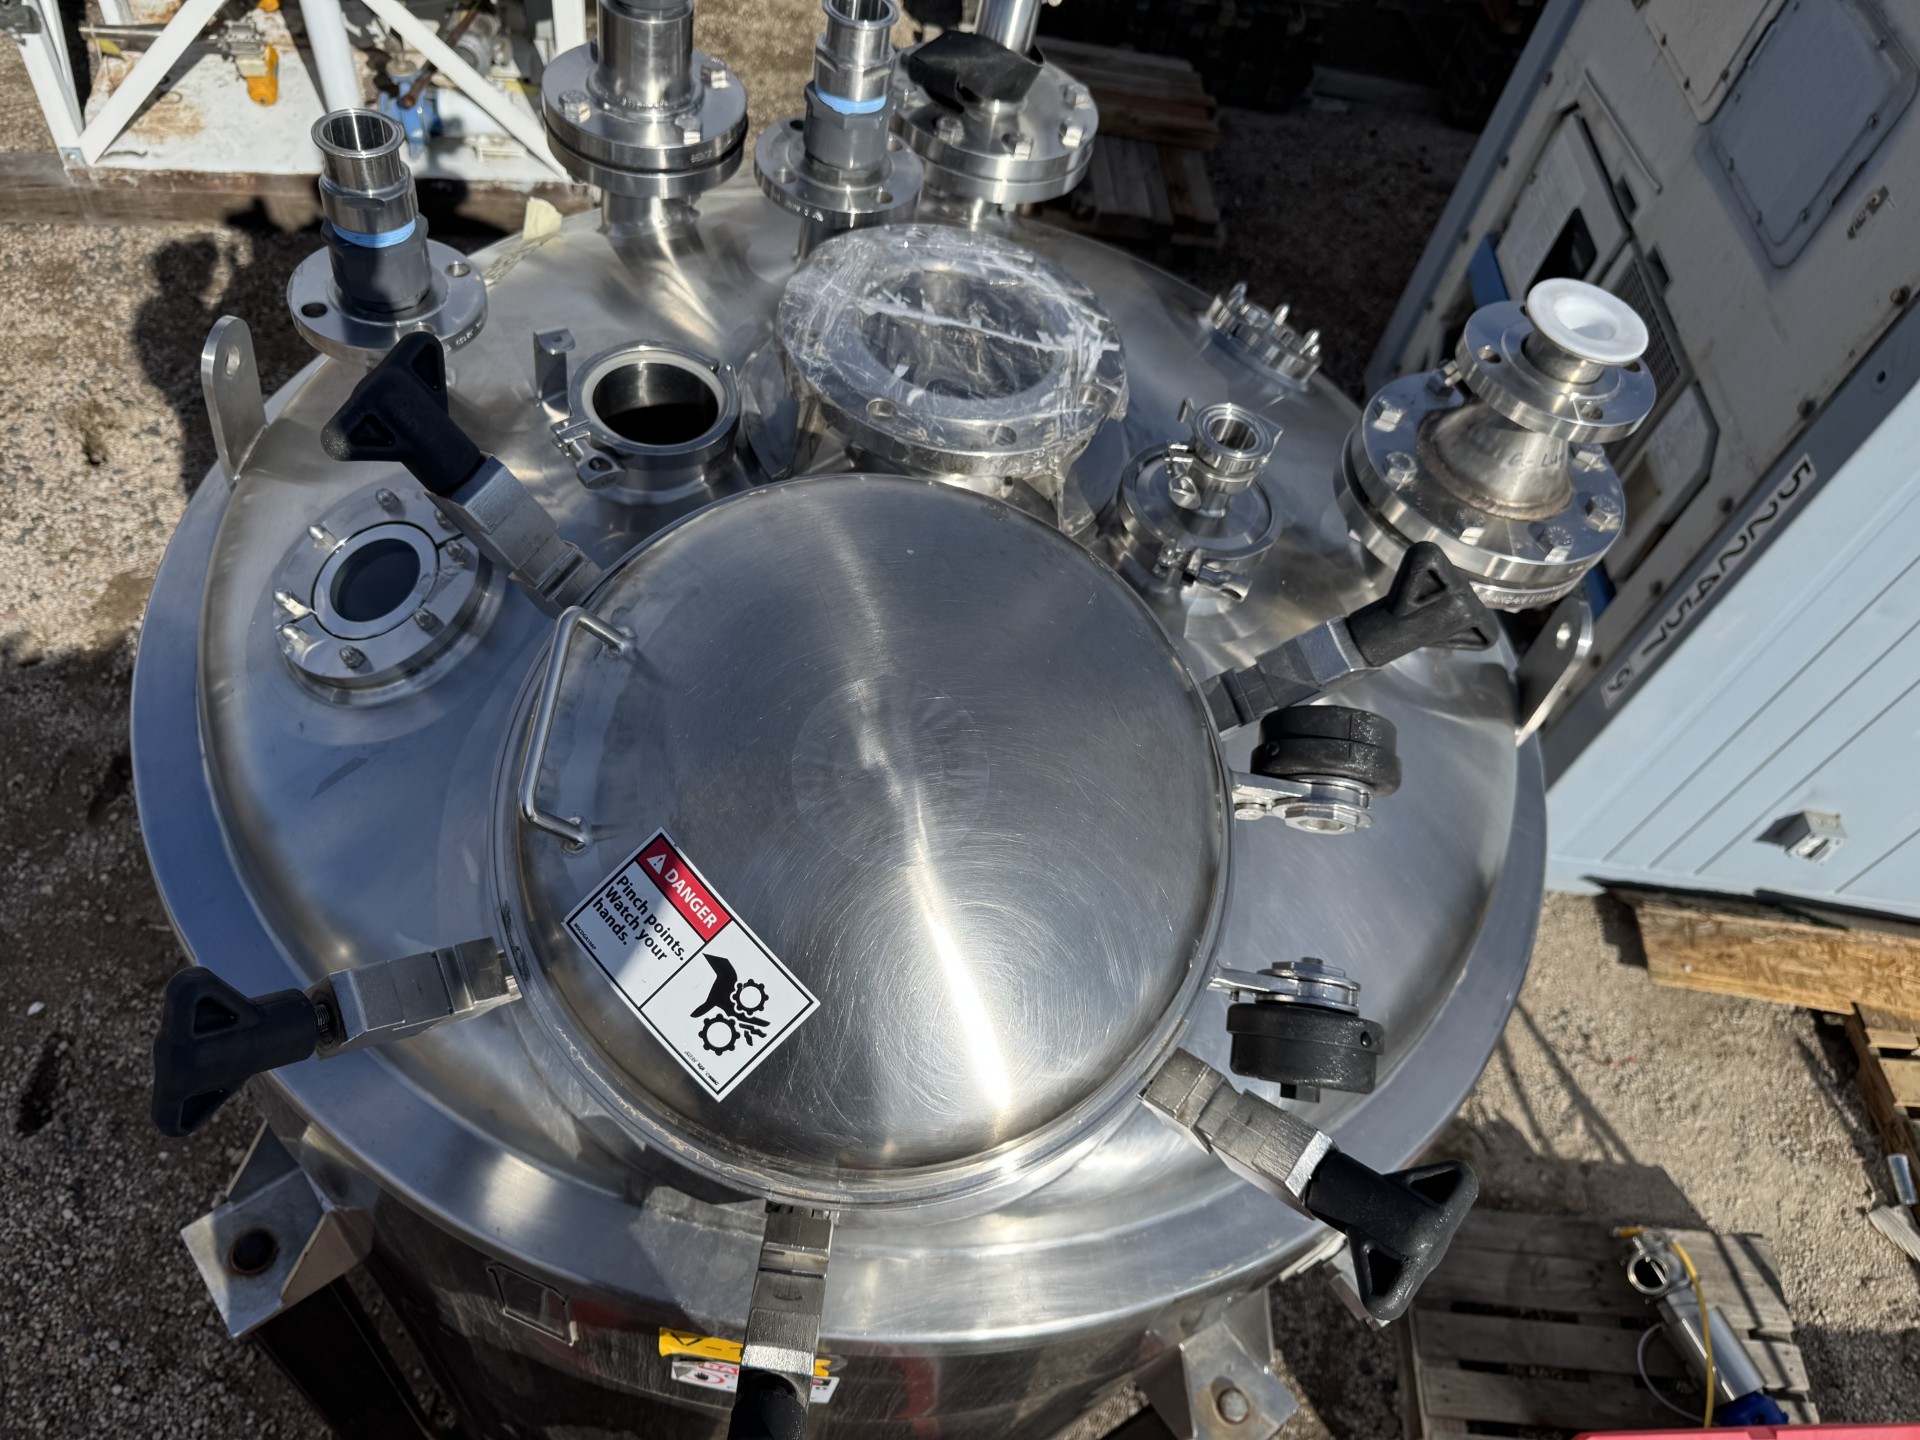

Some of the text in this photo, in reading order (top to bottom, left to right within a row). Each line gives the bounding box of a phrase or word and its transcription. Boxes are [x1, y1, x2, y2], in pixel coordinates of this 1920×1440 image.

[592, 897, 628, 946] hands.
[605, 886, 668, 961] Watch your
[616, 875, 685, 961] Pinch points.
[664, 868, 718, 929] DANGER
